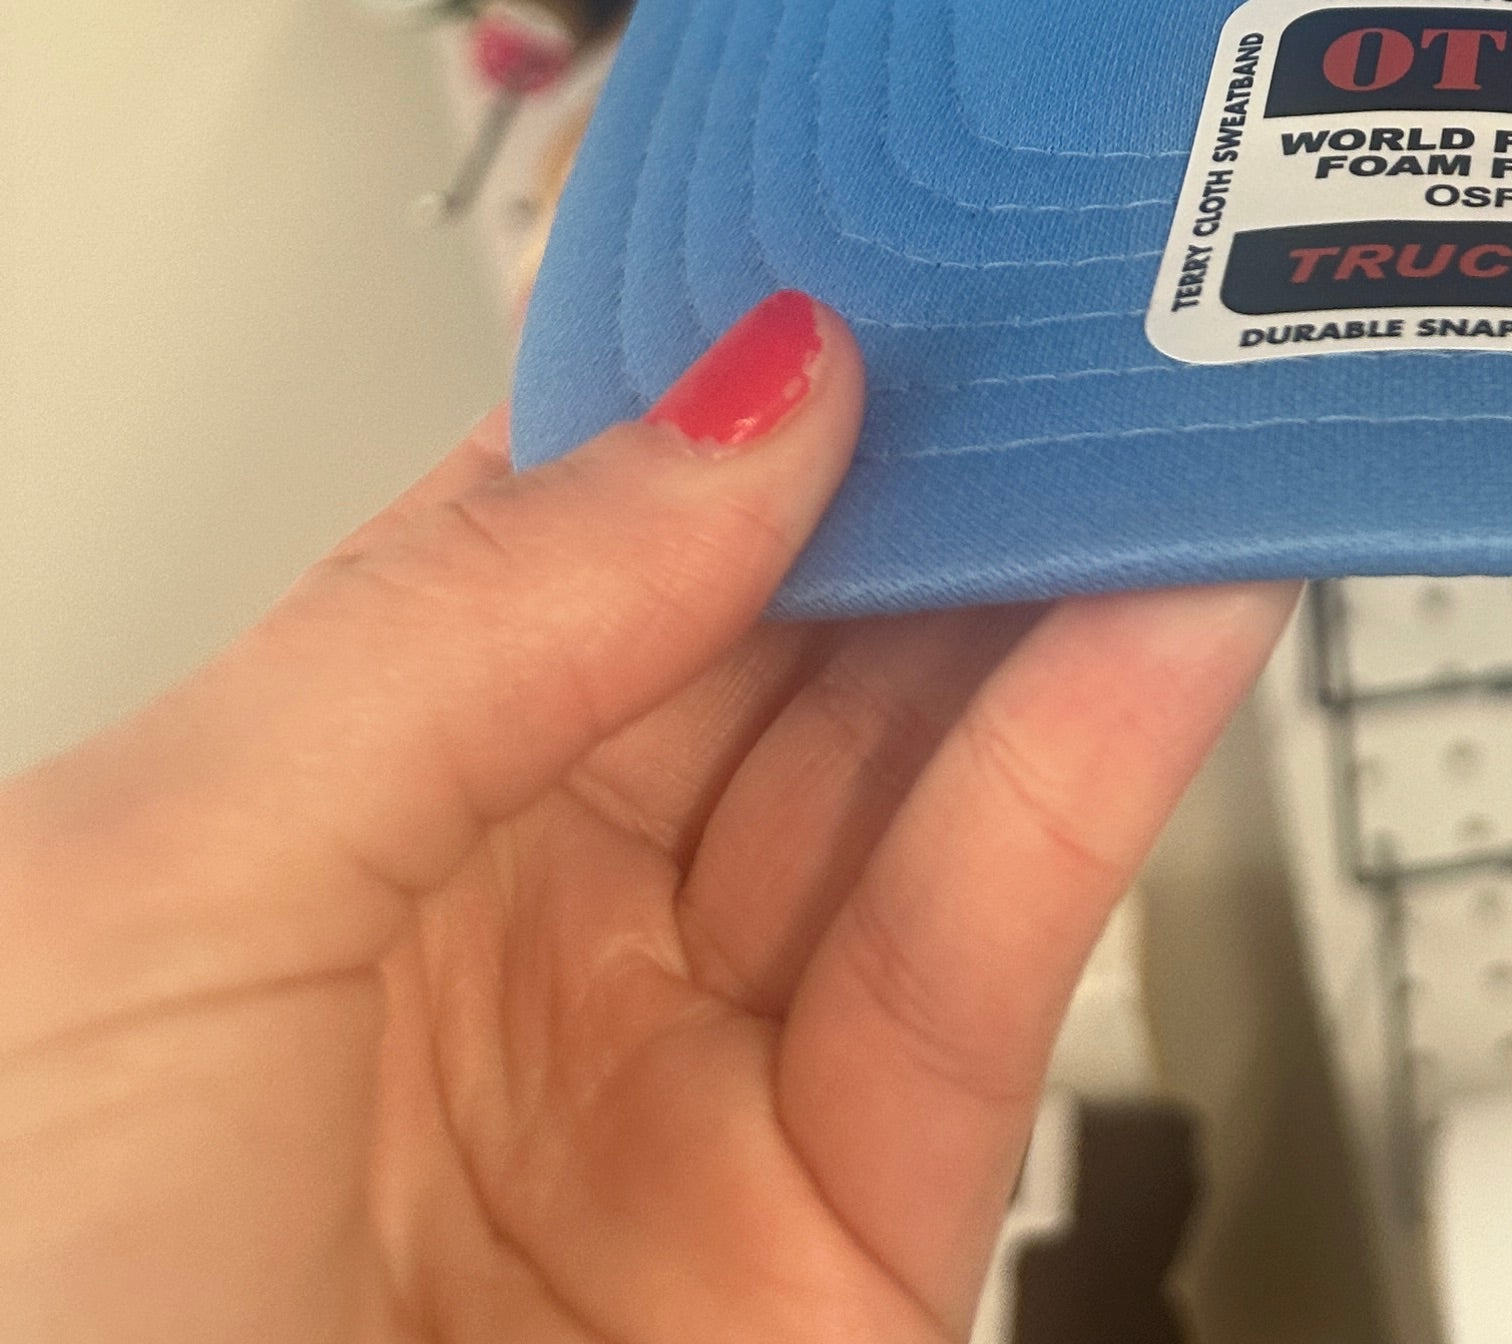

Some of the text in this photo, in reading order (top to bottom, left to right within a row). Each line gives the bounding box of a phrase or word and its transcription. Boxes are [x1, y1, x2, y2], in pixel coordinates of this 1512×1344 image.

[1281, 127, 1475, 155] WORLD
[1171, 32, 1264, 312] TERRY CLOTH SWEATBAND
[1315, 154, 1471, 179] FOAM
[1238, 318, 1406, 348] DURABLE
